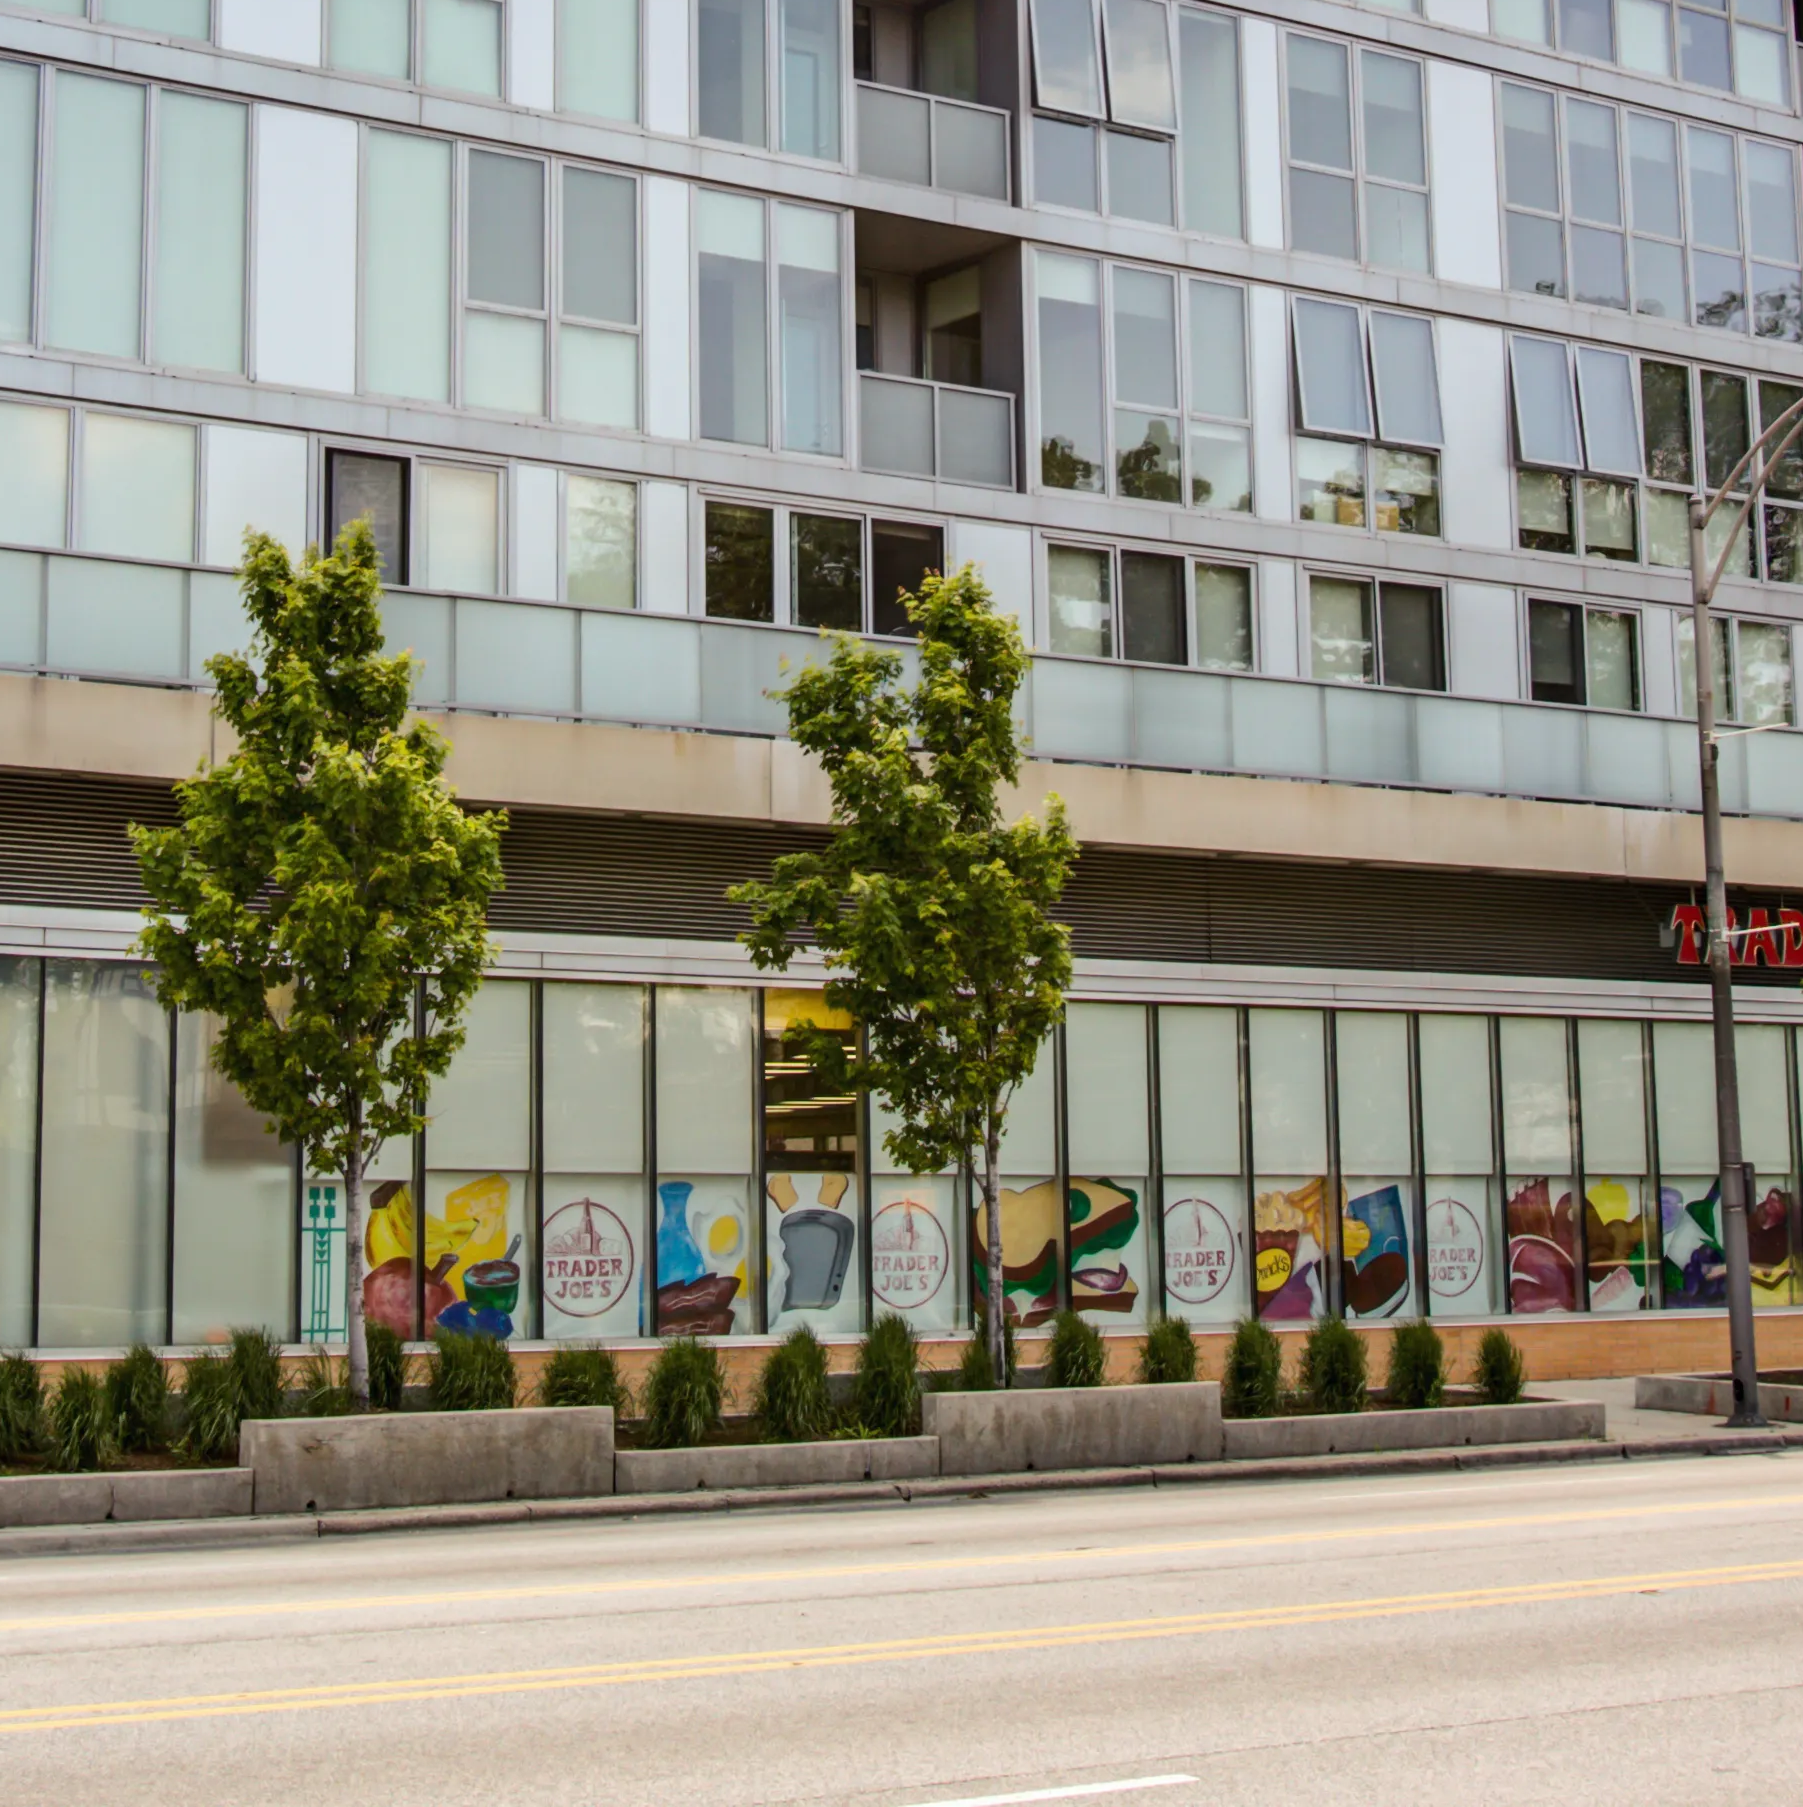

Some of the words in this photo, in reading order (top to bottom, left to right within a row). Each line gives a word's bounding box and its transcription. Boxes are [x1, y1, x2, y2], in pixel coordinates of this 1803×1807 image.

[873, 1255, 940, 1272] TRADER
[1429, 1247, 1476, 1263] RADER
[546, 1258, 623, 1278] TRADER
[880, 1275, 929, 1291] JOES
[1173, 1270, 1218, 1287] JOE'S
[555, 1280, 612, 1298] JOE'S
